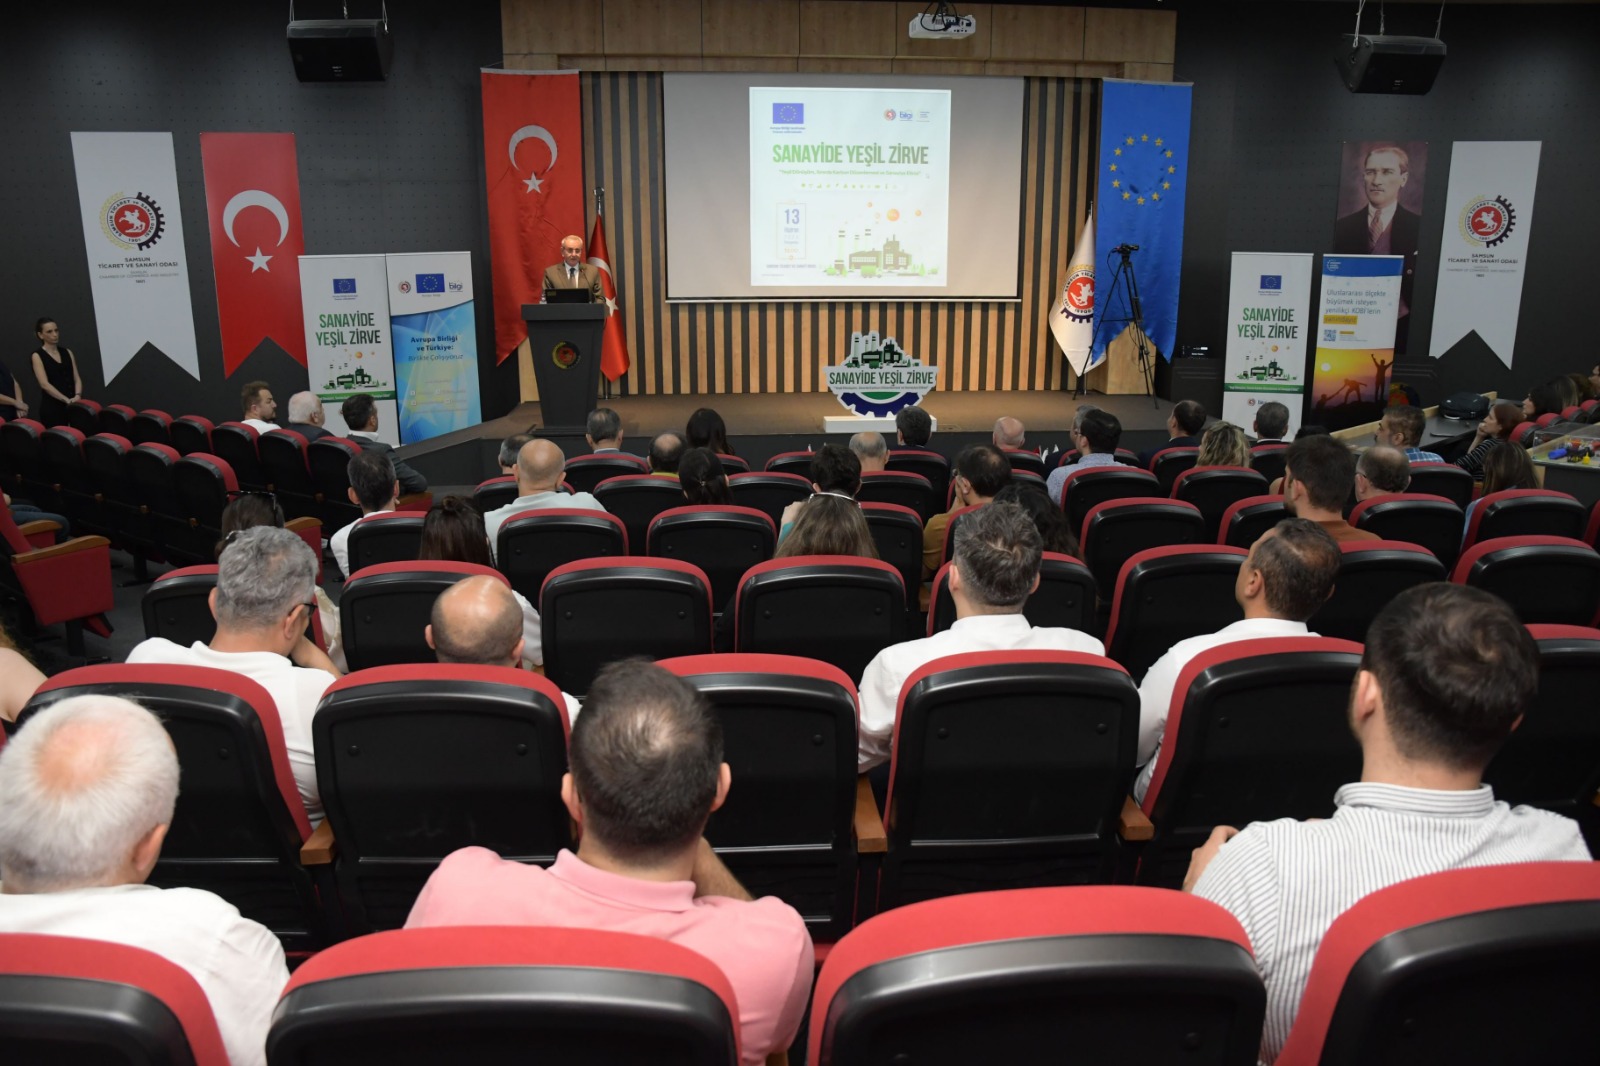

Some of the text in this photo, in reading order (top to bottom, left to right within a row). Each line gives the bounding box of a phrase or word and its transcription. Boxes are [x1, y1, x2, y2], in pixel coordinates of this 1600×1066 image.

[772, 142, 929, 167] SANAYİDE YEŞİL ZİRVE
[784, 209, 800, 224] 13
[319, 310, 375, 328] SANAYİDE
[1243, 306, 1294, 322] SANAYİDE
[315, 328, 382, 348] YEŞİL ZİRVE
[1237, 322, 1298, 340] YEŞİL ZİRVE
[829, 370, 934, 386] SANAYİDE YEŞİL ZİRVE
